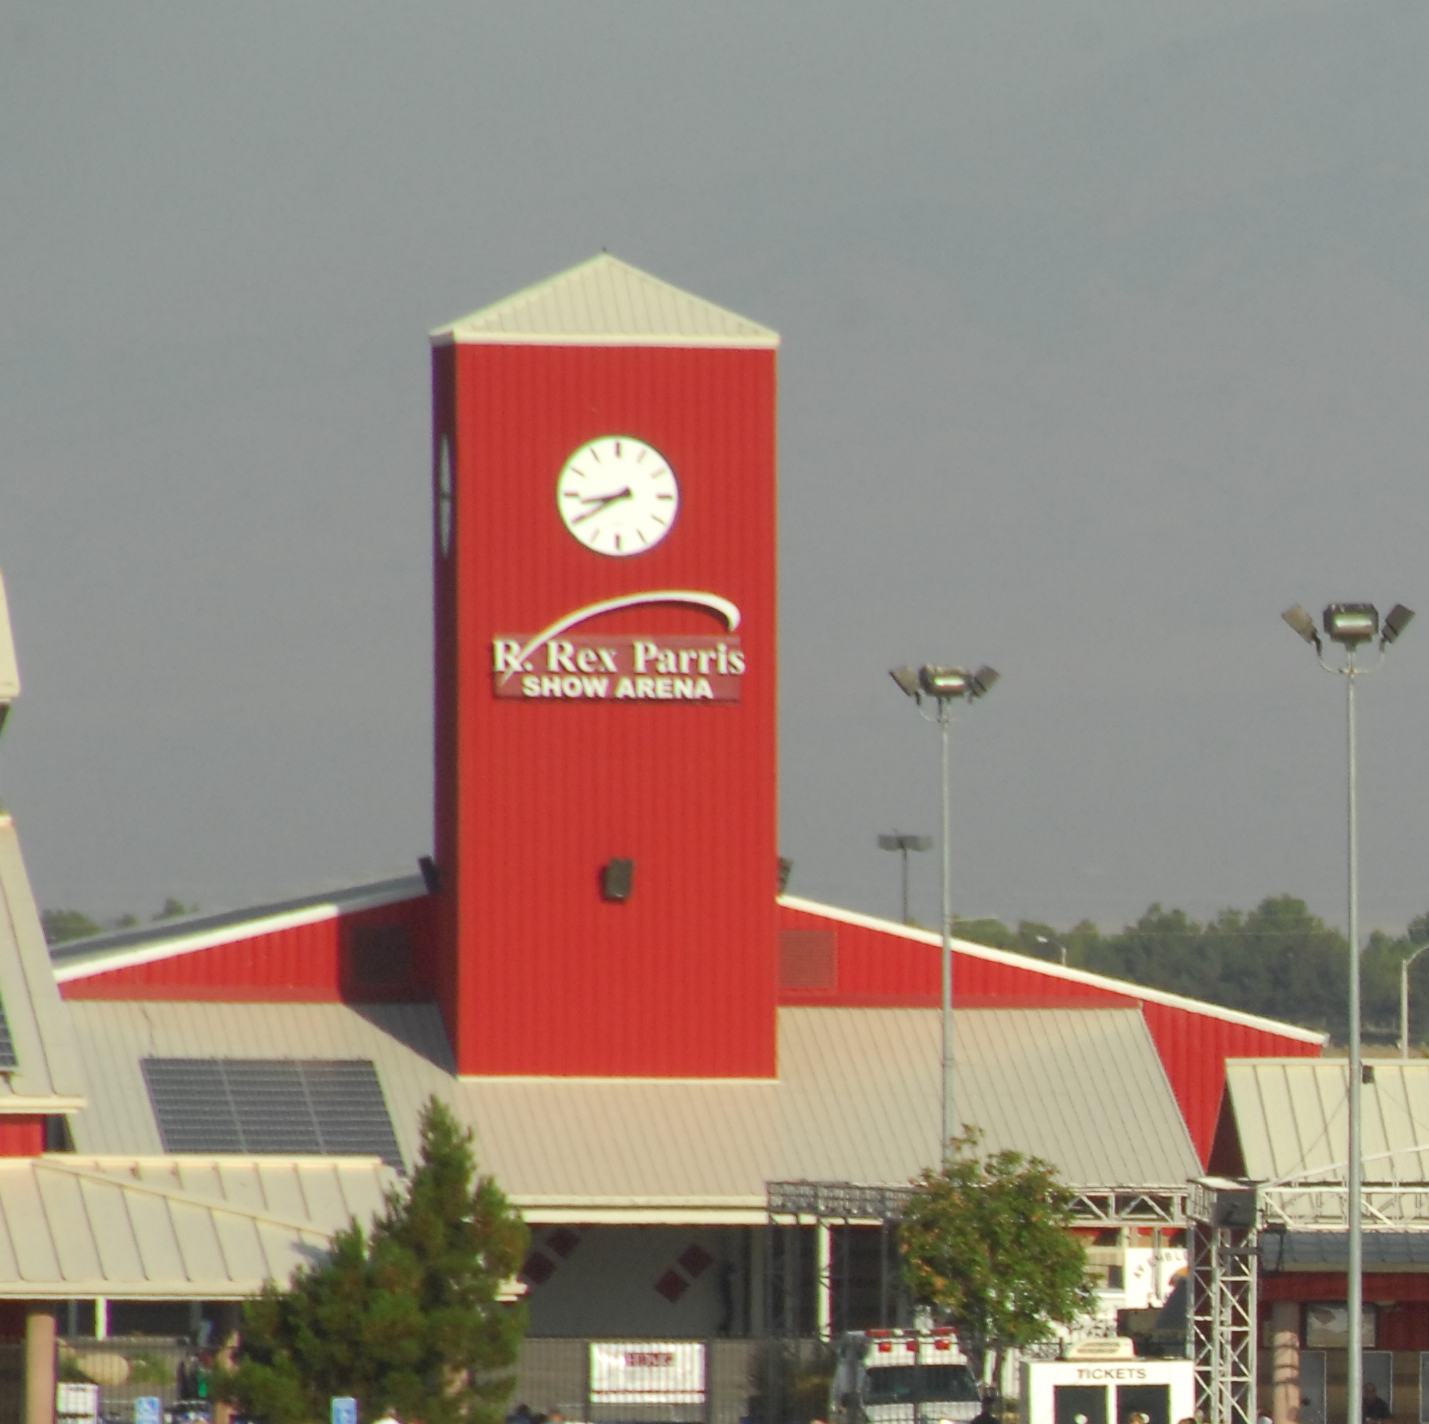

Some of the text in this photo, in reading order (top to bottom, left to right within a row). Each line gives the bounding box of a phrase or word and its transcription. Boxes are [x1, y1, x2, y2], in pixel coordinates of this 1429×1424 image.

[494, 640, 746, 675] R. Rex Parris
[522, 675, 714, 700] SHOW ARENA
[1077, 1368, 1147, 1380] TICKETS
